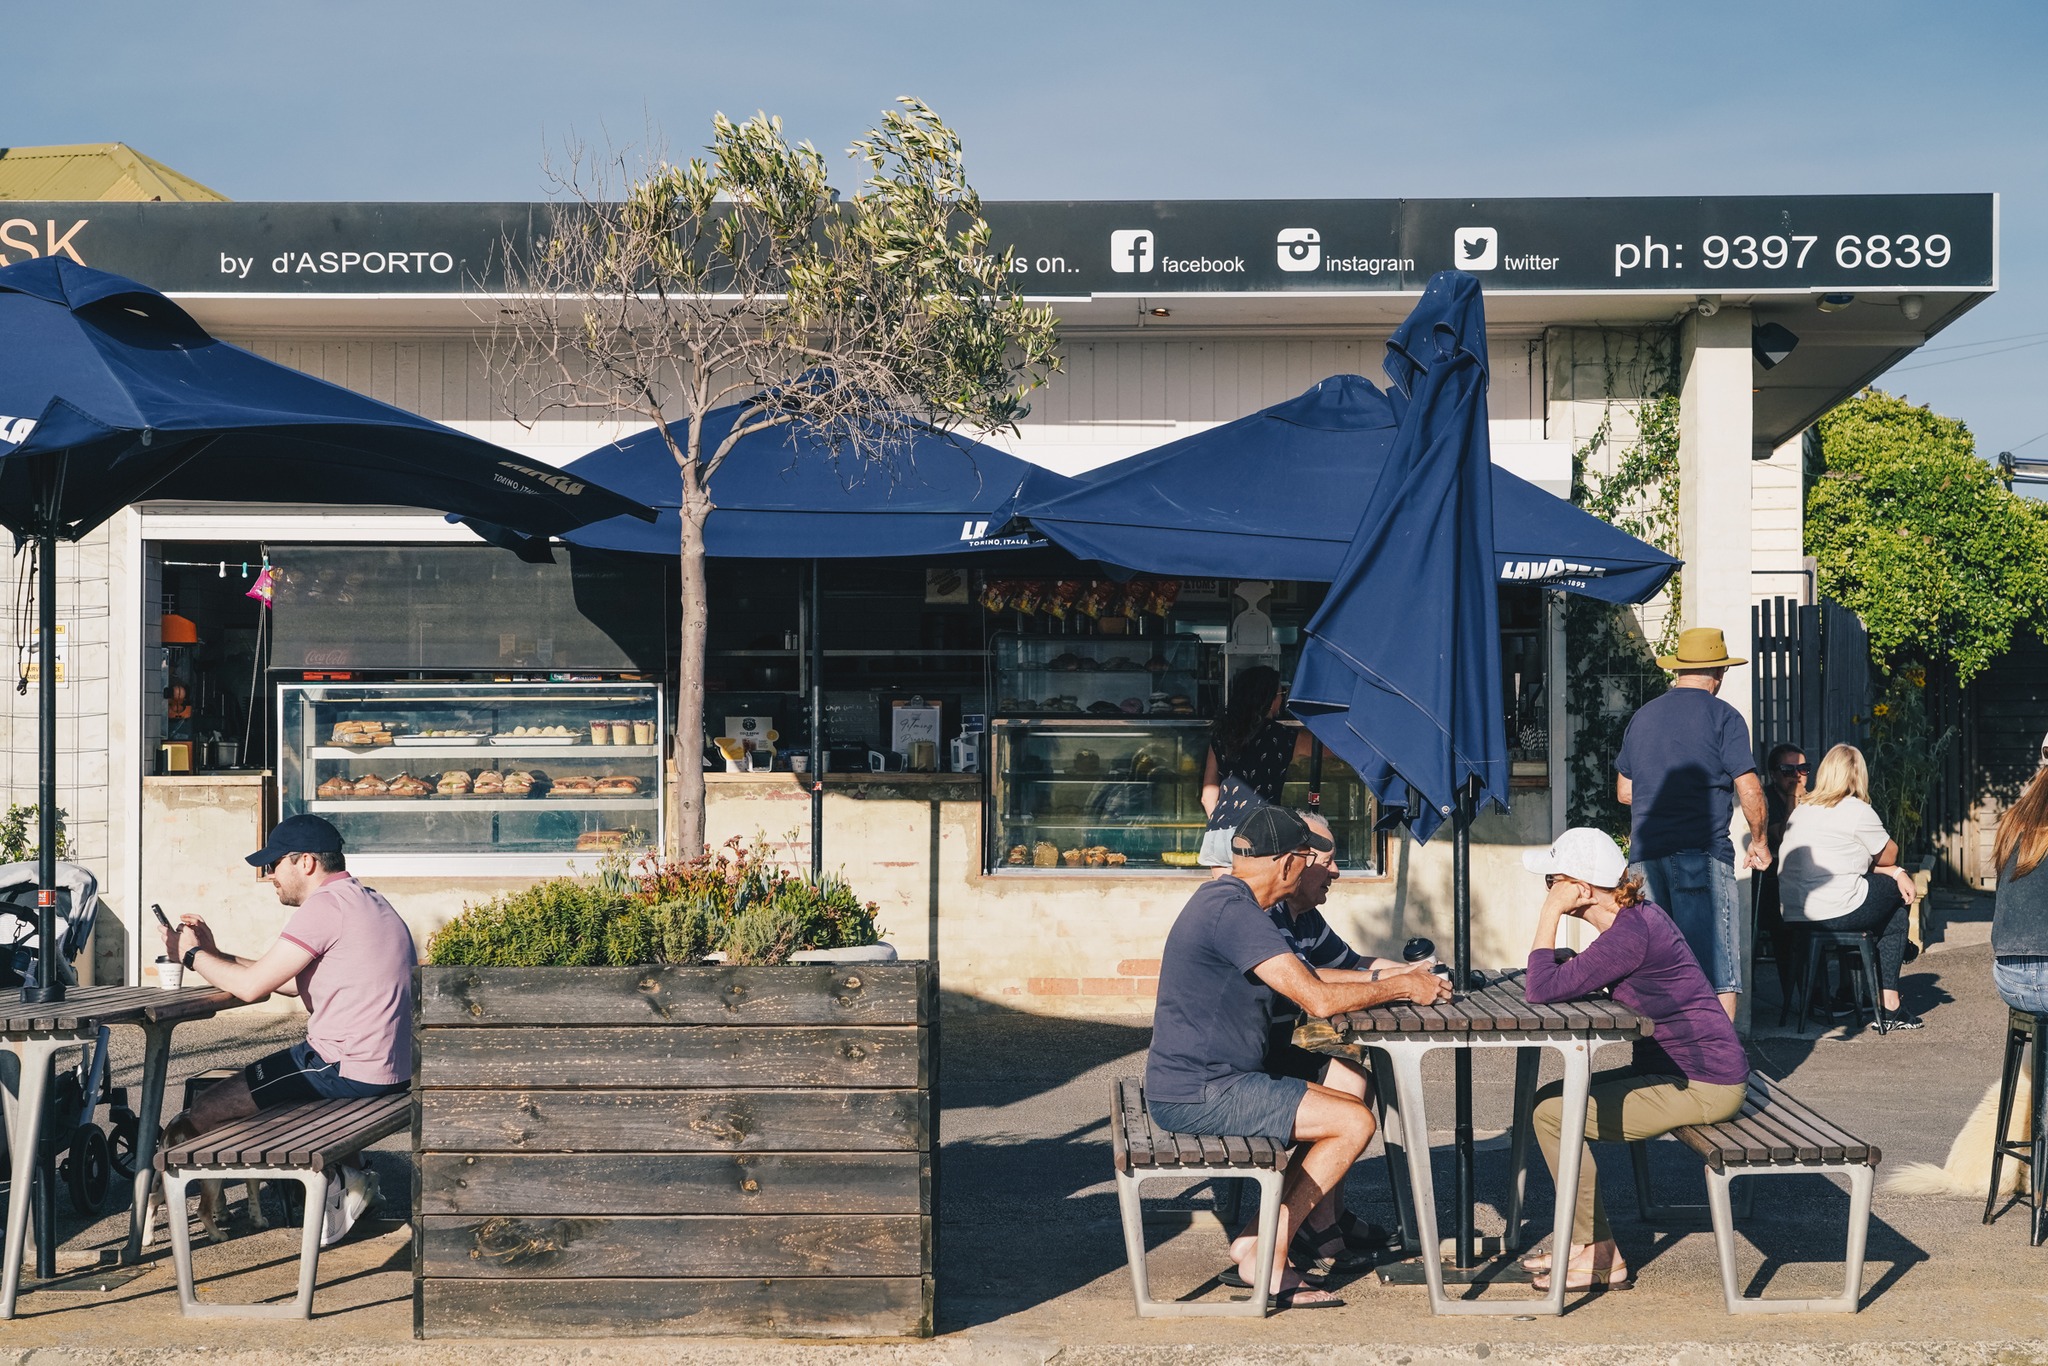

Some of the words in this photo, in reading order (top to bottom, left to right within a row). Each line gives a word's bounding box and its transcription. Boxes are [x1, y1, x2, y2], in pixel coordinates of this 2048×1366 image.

[220, 252, 254, 279] by
[272, 252, 454, 274] d'ASPORTO
[1162, 256, 1245, 272] facebook
[1504, 255, 1560, 271] twitter
[1615, 236, 1683, 278] ph:
[1703, 236, 1818, 269] 9397
[1836, 235, 1952, 268] 6839
[1326, 256, 1415, 276] instagram
[1567, 580, 1586, 589] 1895
